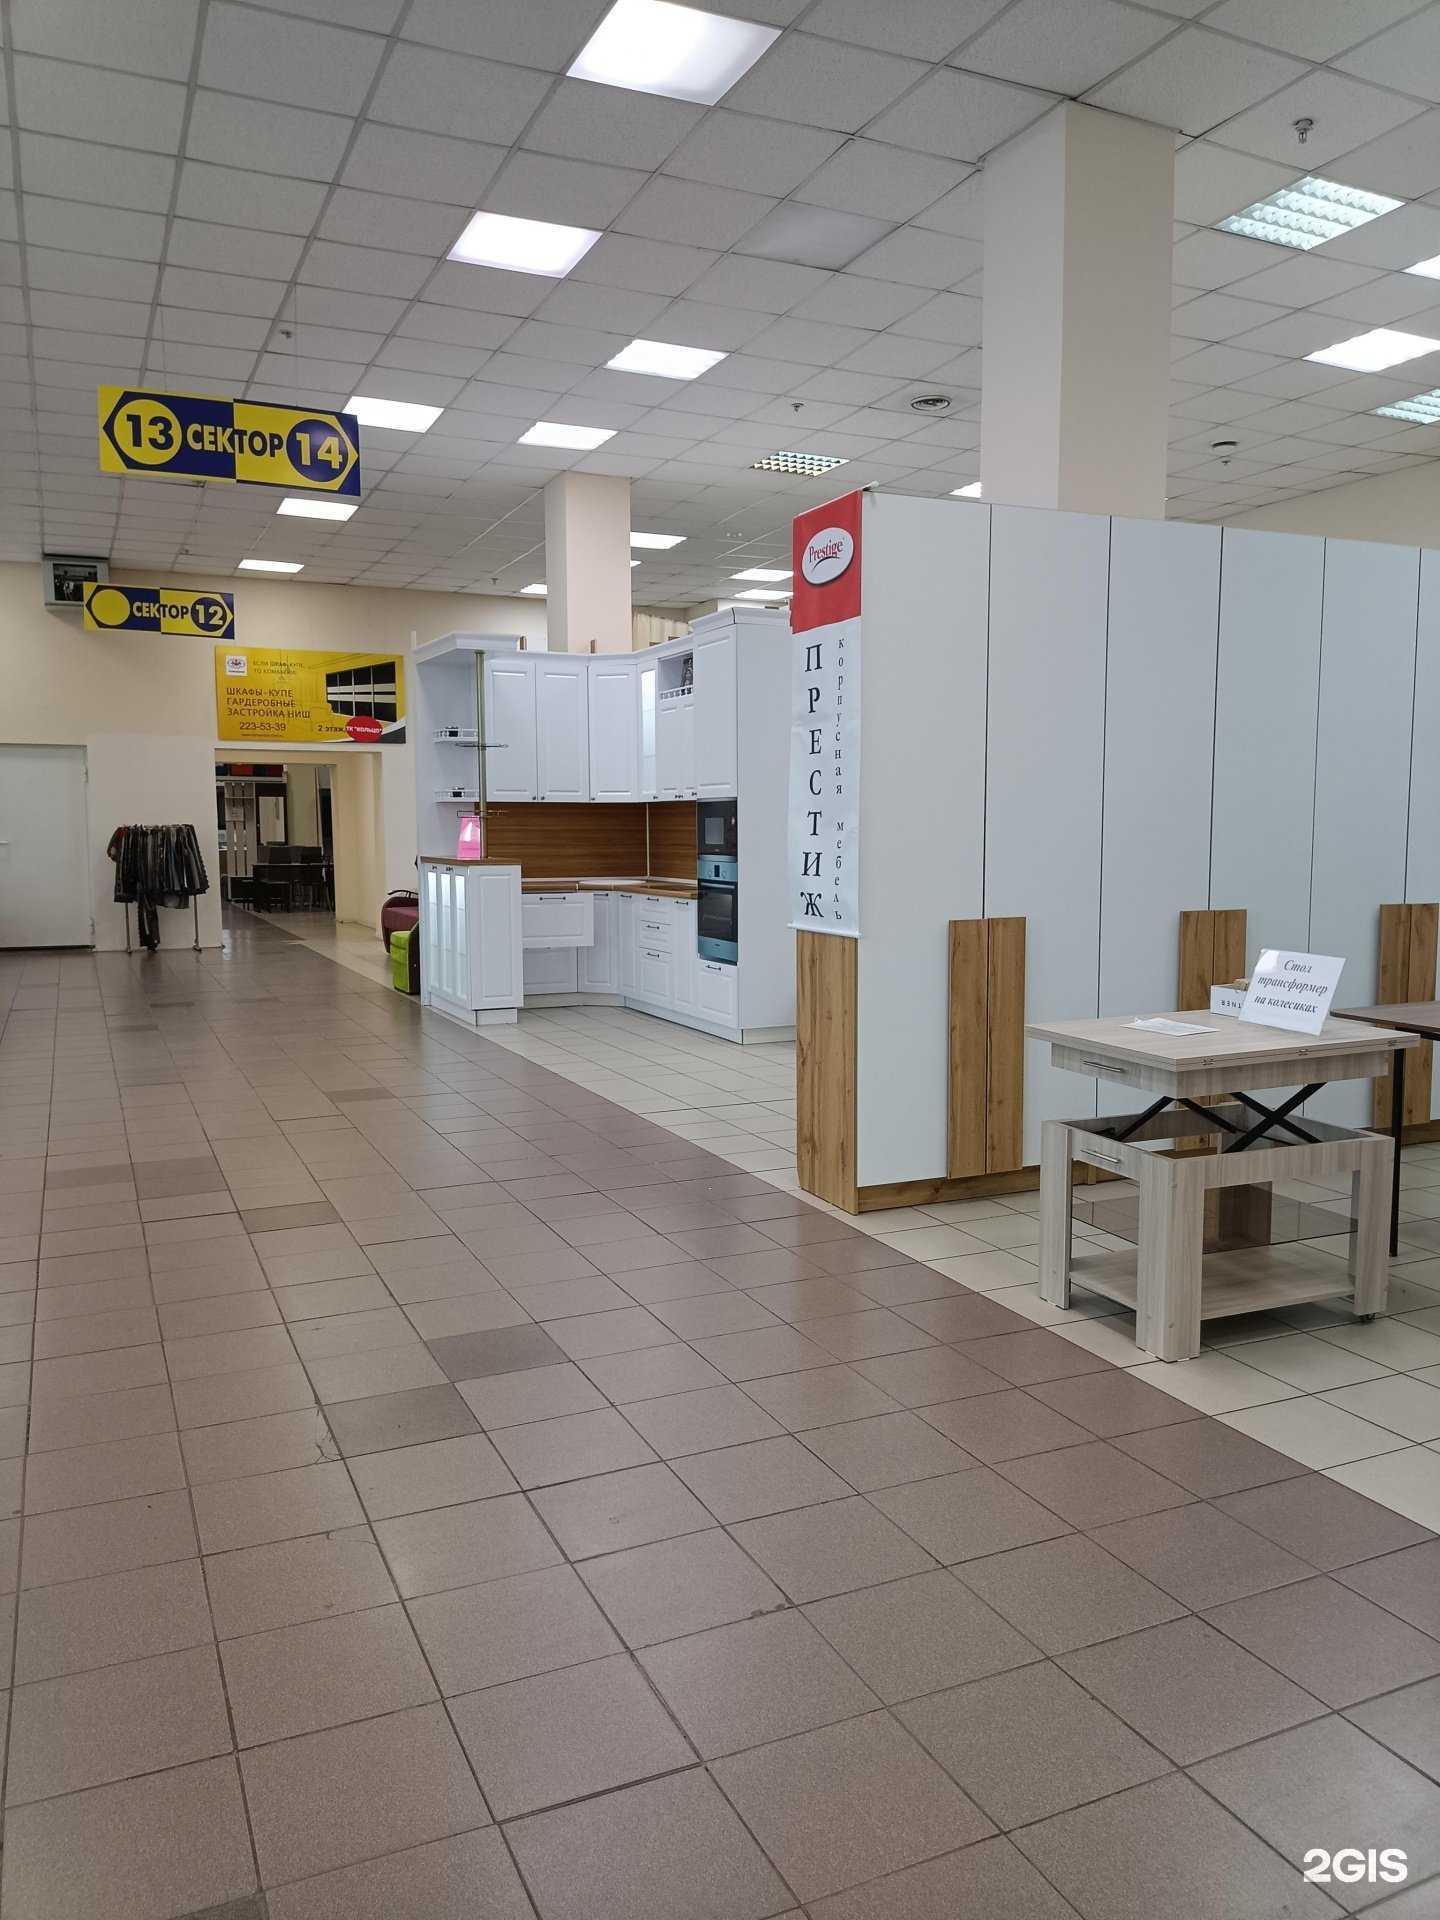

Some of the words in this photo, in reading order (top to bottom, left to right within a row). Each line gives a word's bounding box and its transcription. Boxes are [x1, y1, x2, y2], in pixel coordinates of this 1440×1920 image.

[126, 414, 174, 450] 13
[186, 423, 284, 458] СЕКТОР
[296, 431, 343, 470] 14
[809, 539, 844, 563] Prestige
[132, 601, 189, 620] СЕКТОР
[196, 604, 223, 625] 12
[226, 697, 297, 708] ГАРДЕРОБНЫЕ
[227, 707, 286, 718] ЗАСТРОЙКА
[287, 710, 311, 719] НИШ
[834, 638, 845, 795] корпусная
[800, 643, 824, 918] ПРЕСТИЖ
[833, 821, 844, 920] мебель
[1283, 959, 1313, 974] Стол
[1257, 976, 1329, 997] трансформер
[1254, 995, 1267, 1005] на
[1267, 997, 1319, 1014] колесиках
